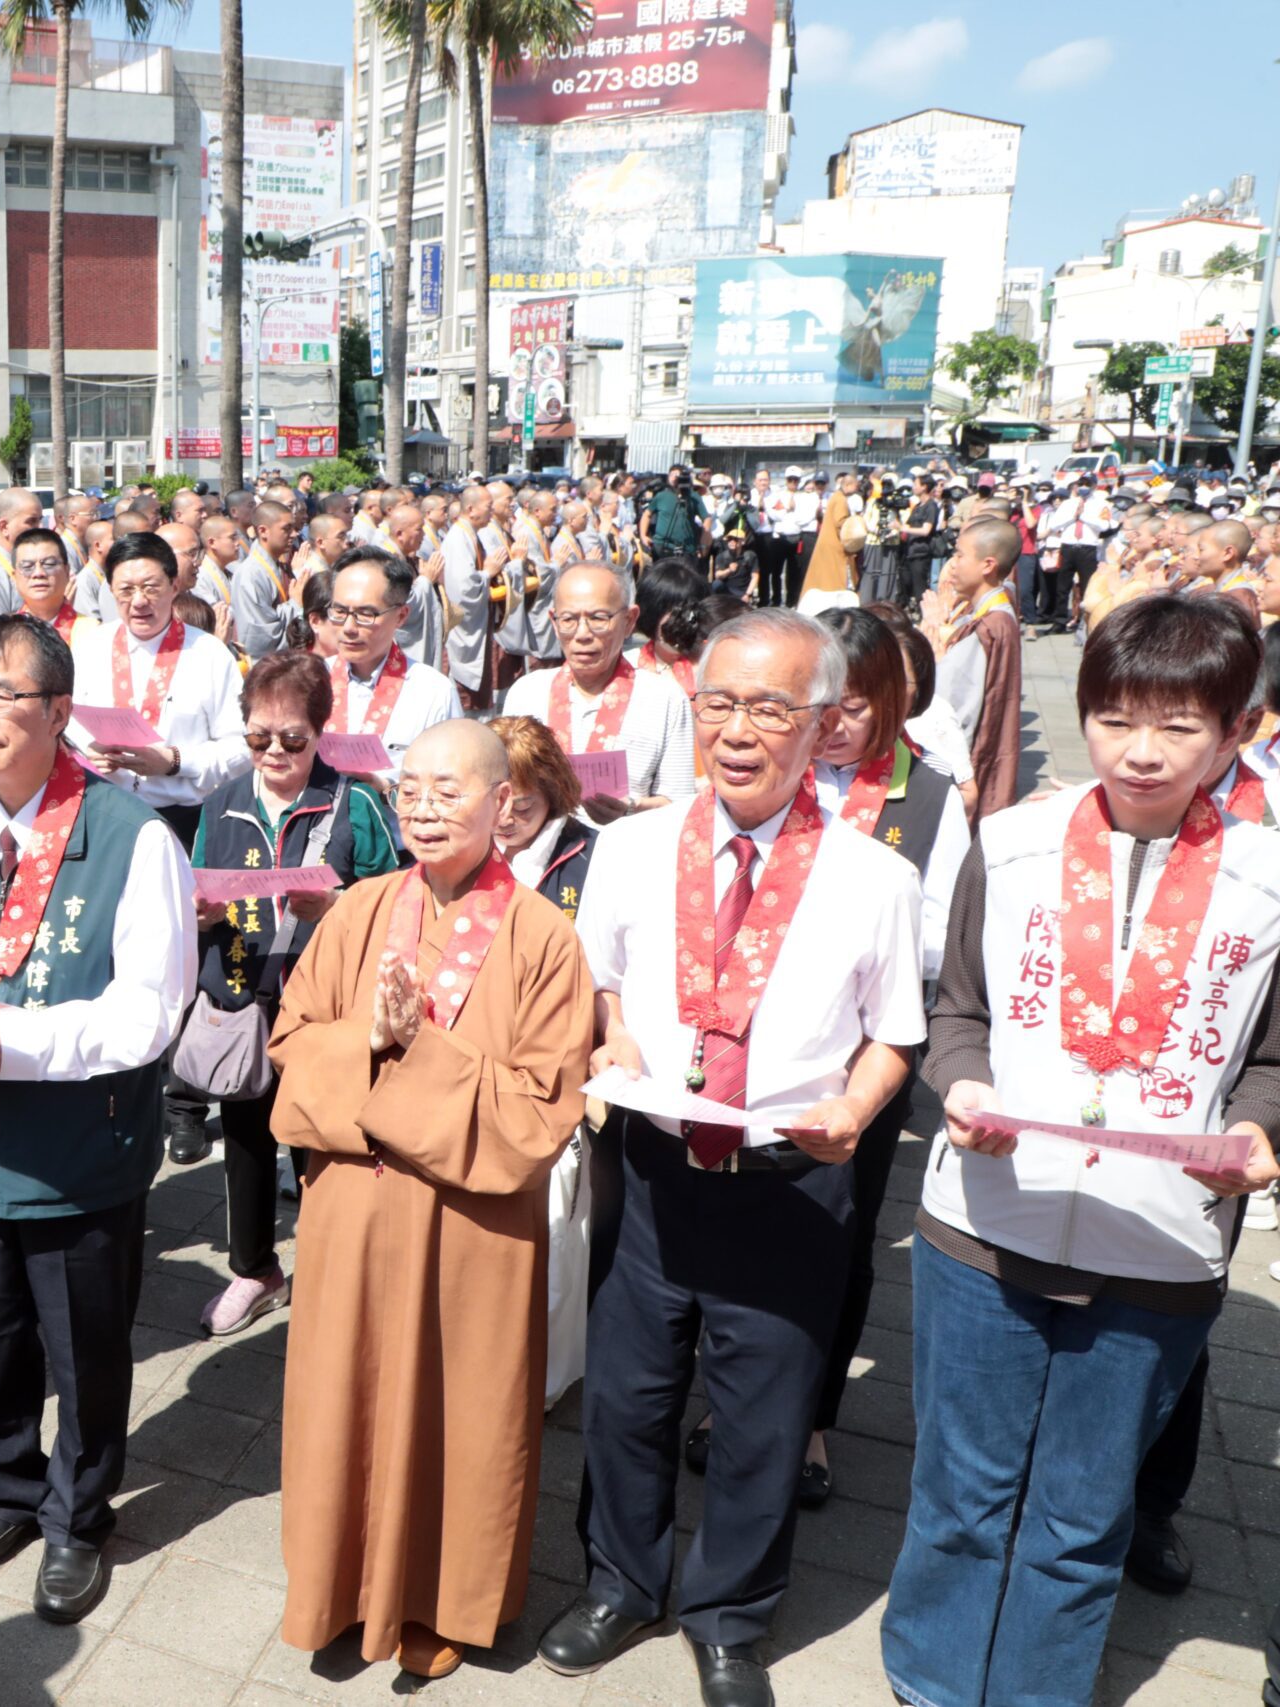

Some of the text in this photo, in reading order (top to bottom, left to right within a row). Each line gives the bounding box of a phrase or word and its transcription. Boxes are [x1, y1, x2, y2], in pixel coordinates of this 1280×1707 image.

[636, 0, 748, 28] 國際建築
[668, 26, 746, 51] 25-75坪
[716, 318, 828, 356] 就愛上
[58, 895, 86, 954] 市長
[1007, 903, 1062, 1029] 陳怡珍
[1188, 931, 1255, 1066] 陳亭妃
[1146, 1097, 1188, 1116] 團隊
